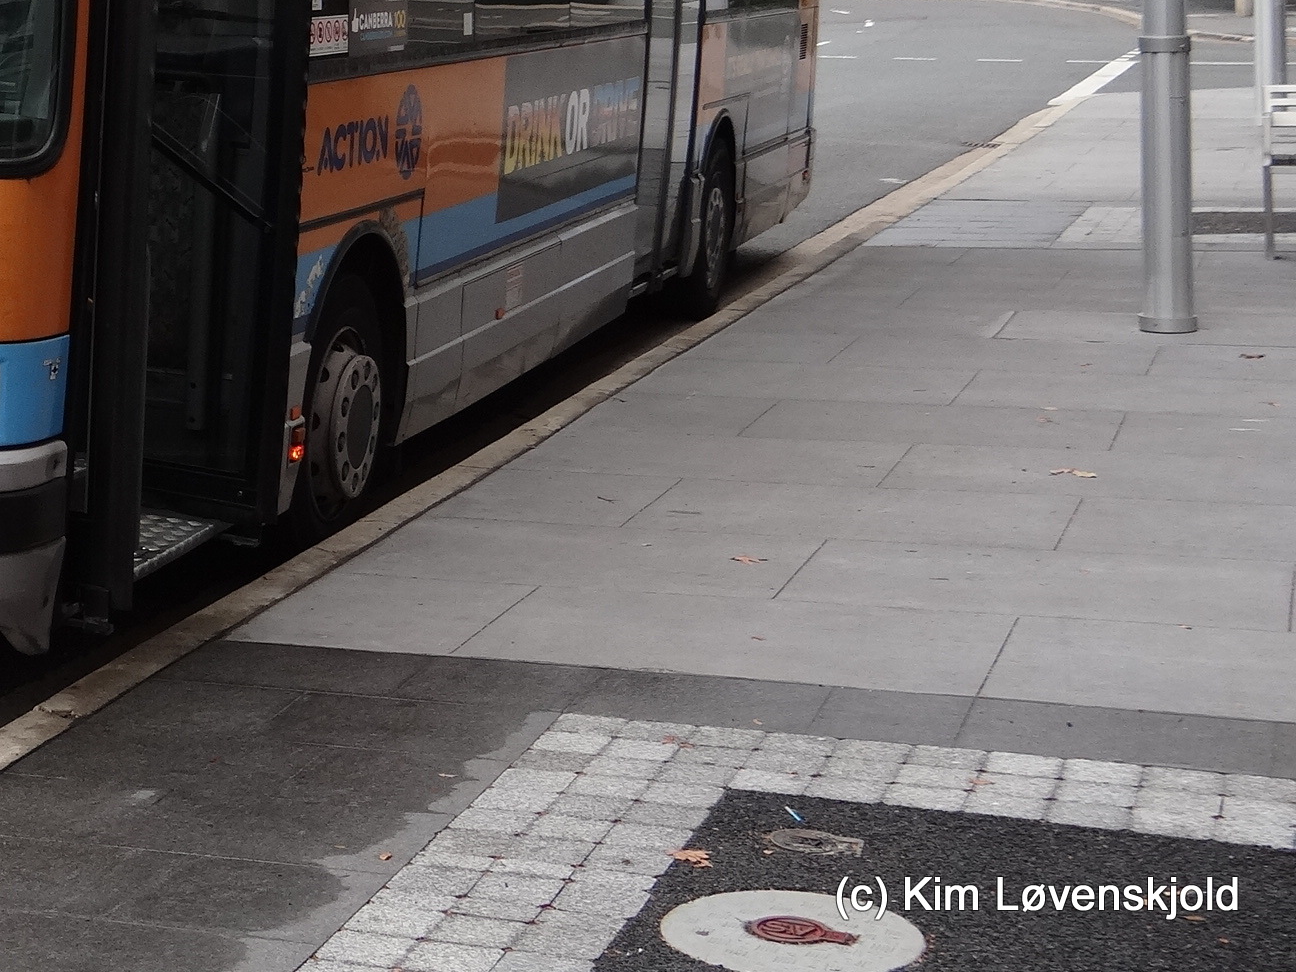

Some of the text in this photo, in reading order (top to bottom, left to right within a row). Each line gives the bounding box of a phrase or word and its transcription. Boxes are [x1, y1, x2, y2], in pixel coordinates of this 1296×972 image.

[359, 11, 393, 30] CANBERRA
[316, 114, 389, 176] ACTION
[504, 93, 566, 176] DRINK
[565, 88, 590, 155] OR
